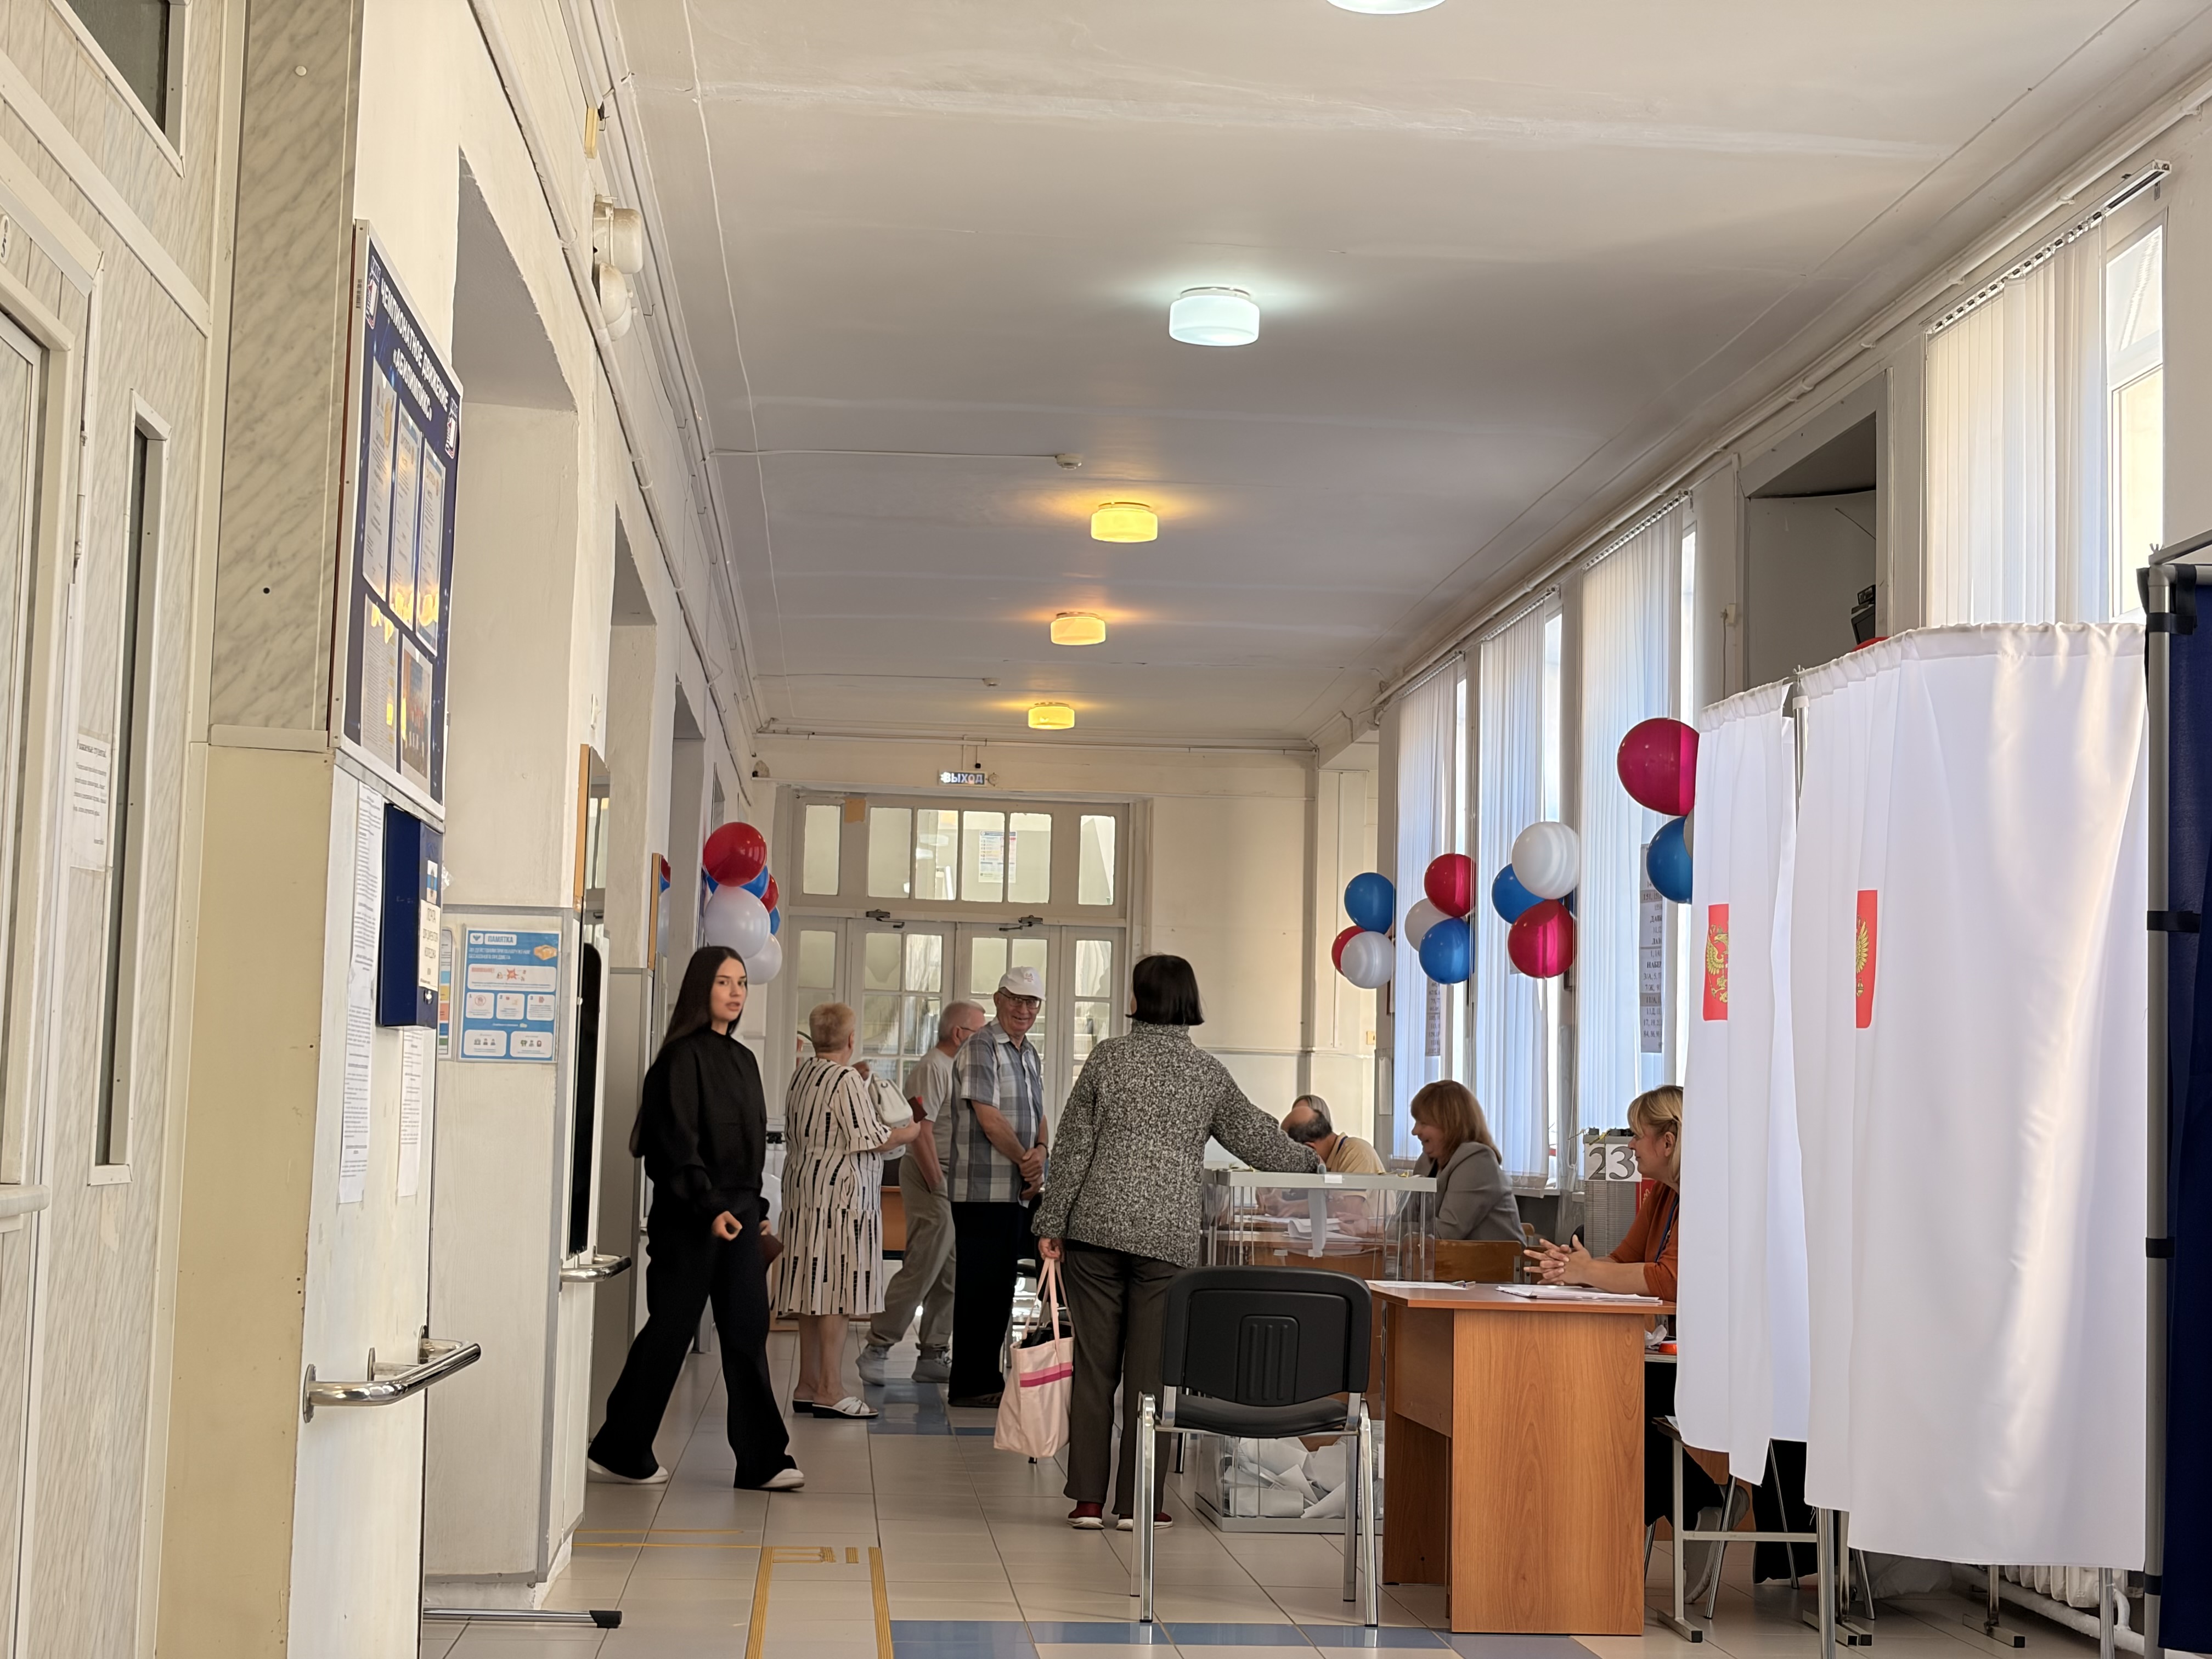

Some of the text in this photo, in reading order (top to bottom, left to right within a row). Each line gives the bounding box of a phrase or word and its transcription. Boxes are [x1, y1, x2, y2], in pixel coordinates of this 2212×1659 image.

[381, 277, 449, 412] ЧЕМПИОНАТНОЕ ДВИЖЕНИЕ
[393, 347, 432, 421] «АБИЛИМПИКС»
[943, 772, 983, 785] ВЫХОД
